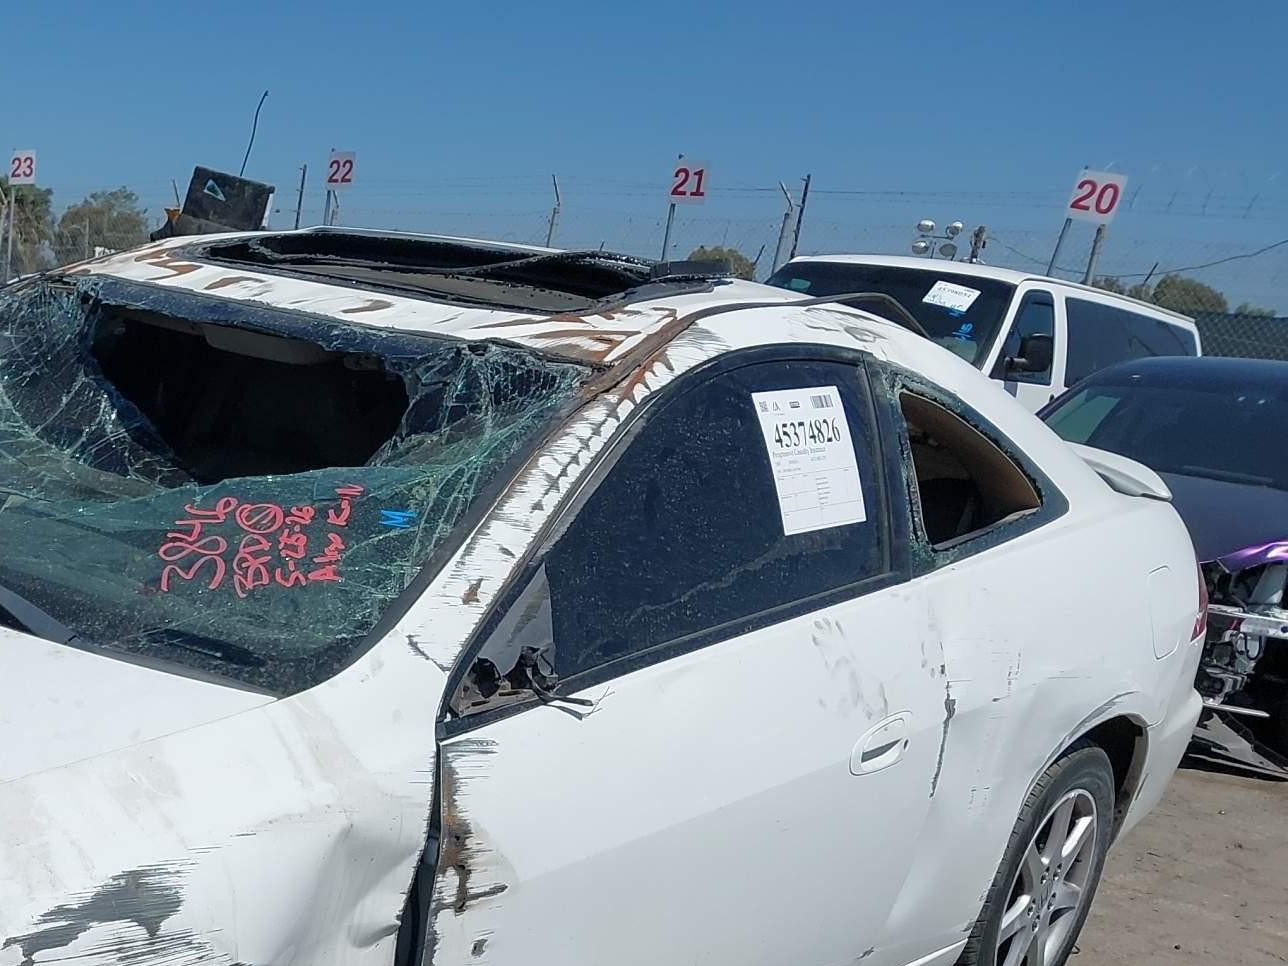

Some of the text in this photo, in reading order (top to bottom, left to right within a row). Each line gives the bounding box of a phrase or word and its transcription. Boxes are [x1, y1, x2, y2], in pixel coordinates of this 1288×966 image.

[10, 156, 34, 178] 23
[327, 159, 354, 184] 22
[670, 167, 705, 197] 21
[1069, 179, 1120, 215] 20
[774, 417, 841, 449] 45374826
[159, 497, 238, 592] 3846
